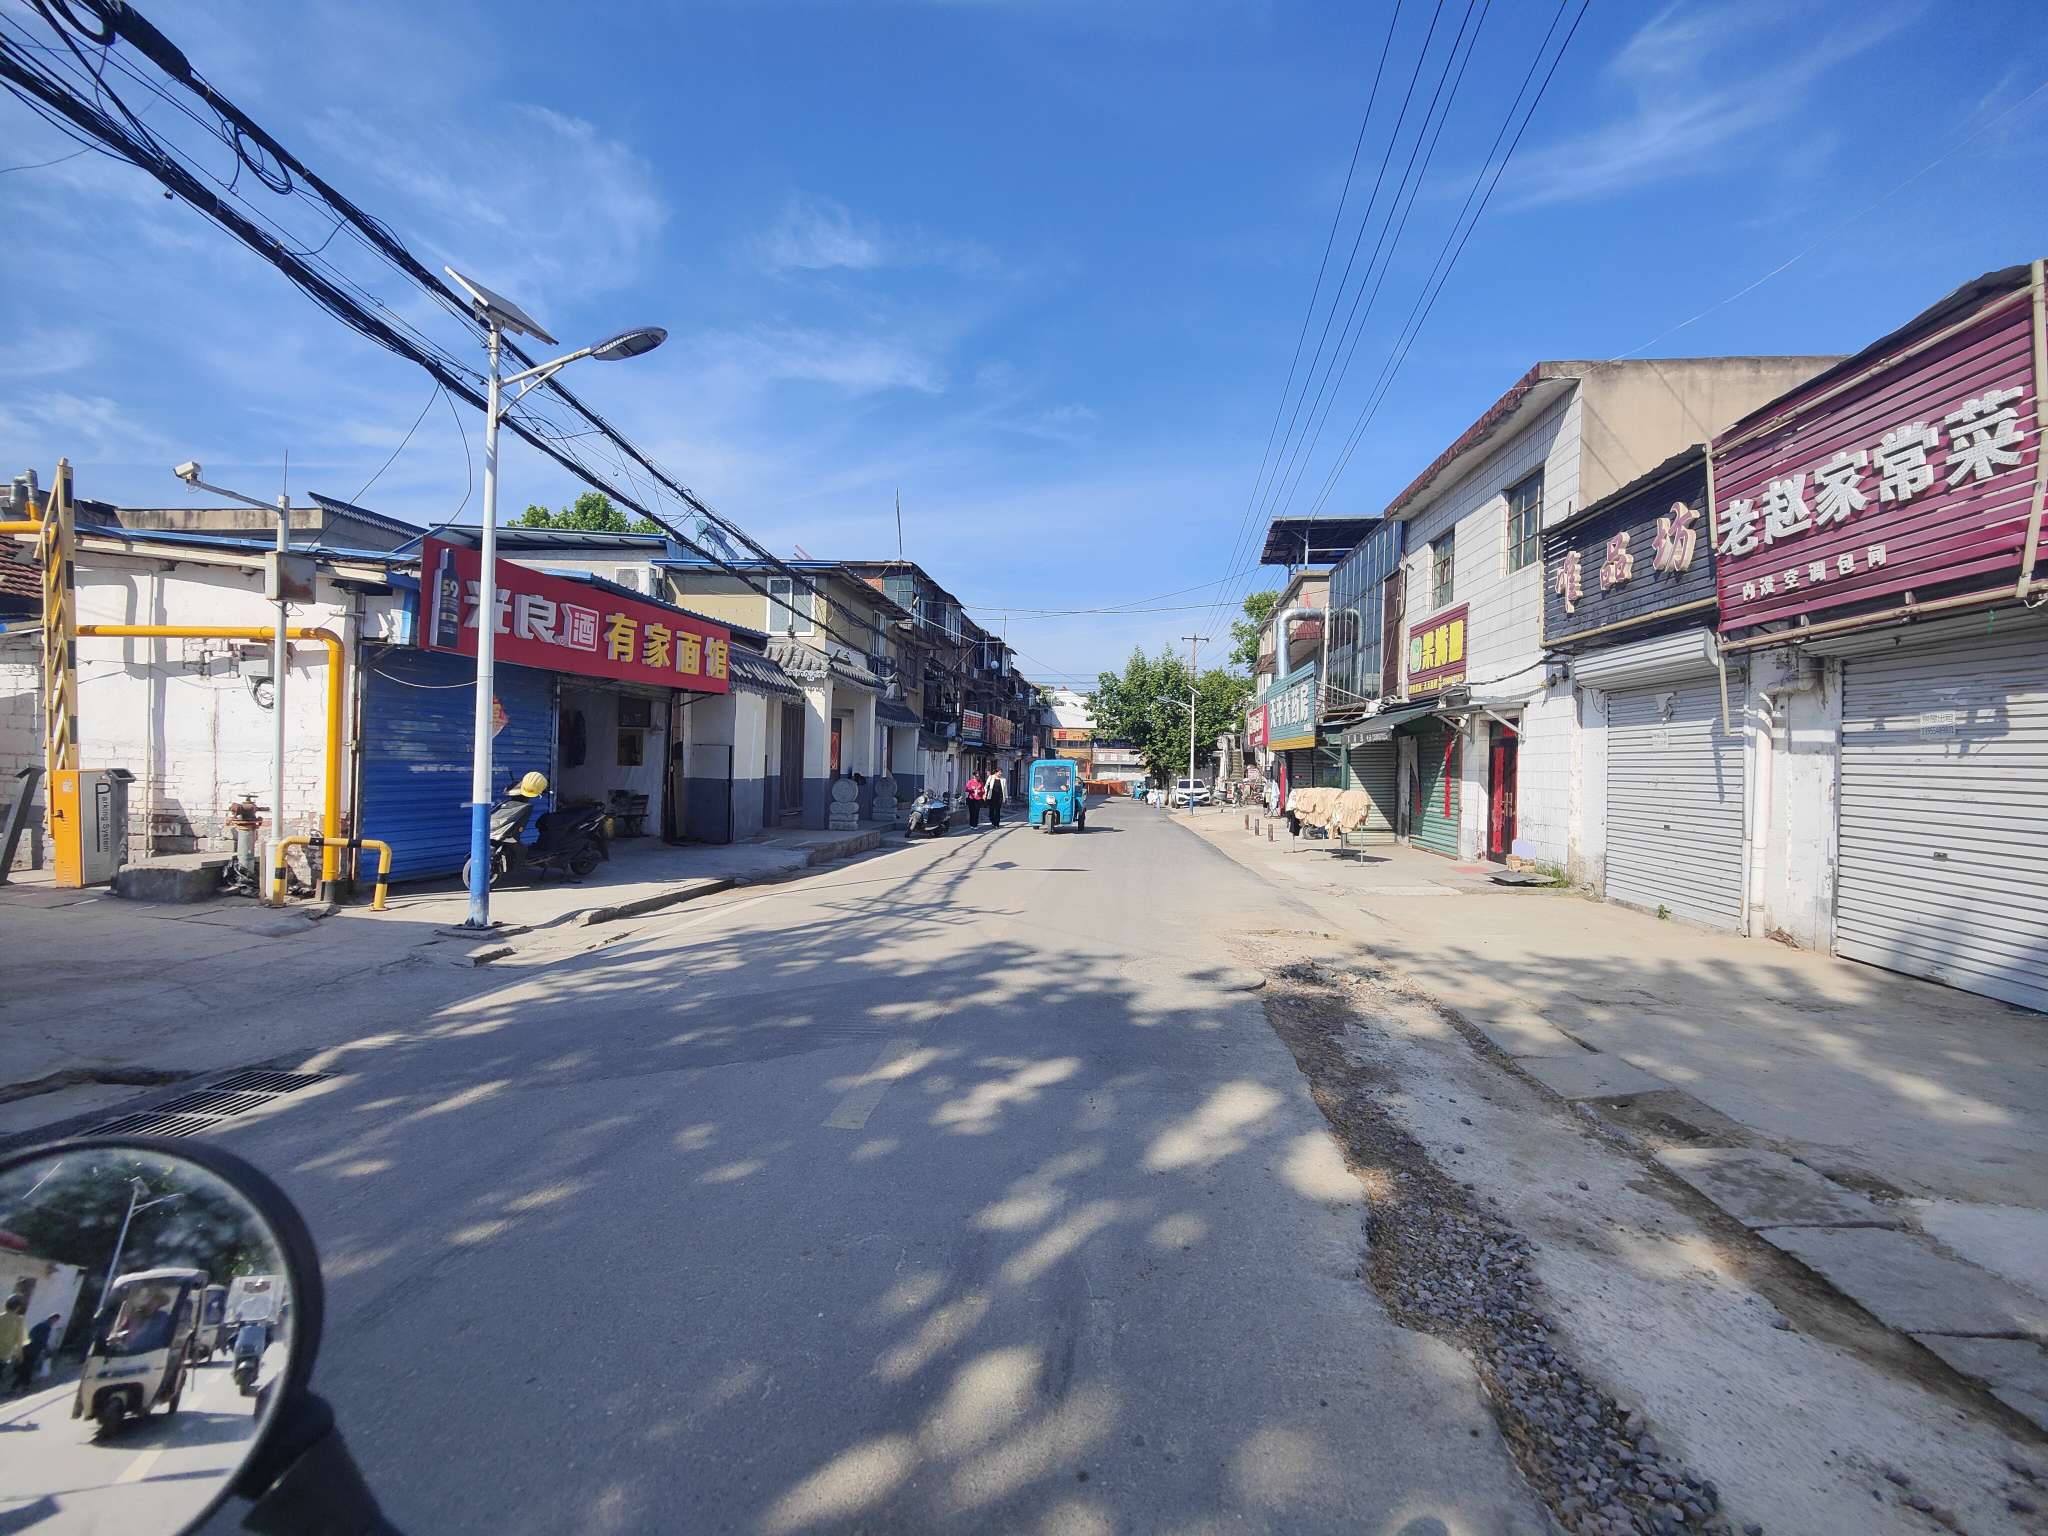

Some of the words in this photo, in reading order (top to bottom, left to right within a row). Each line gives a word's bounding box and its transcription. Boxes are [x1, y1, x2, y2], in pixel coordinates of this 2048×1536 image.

[1718, 386, 2024, 556] 老赵家常菜
[1743, 544, 1887, 601] 内设空调包间
[605, 612, 728, 679] 有家面馆
